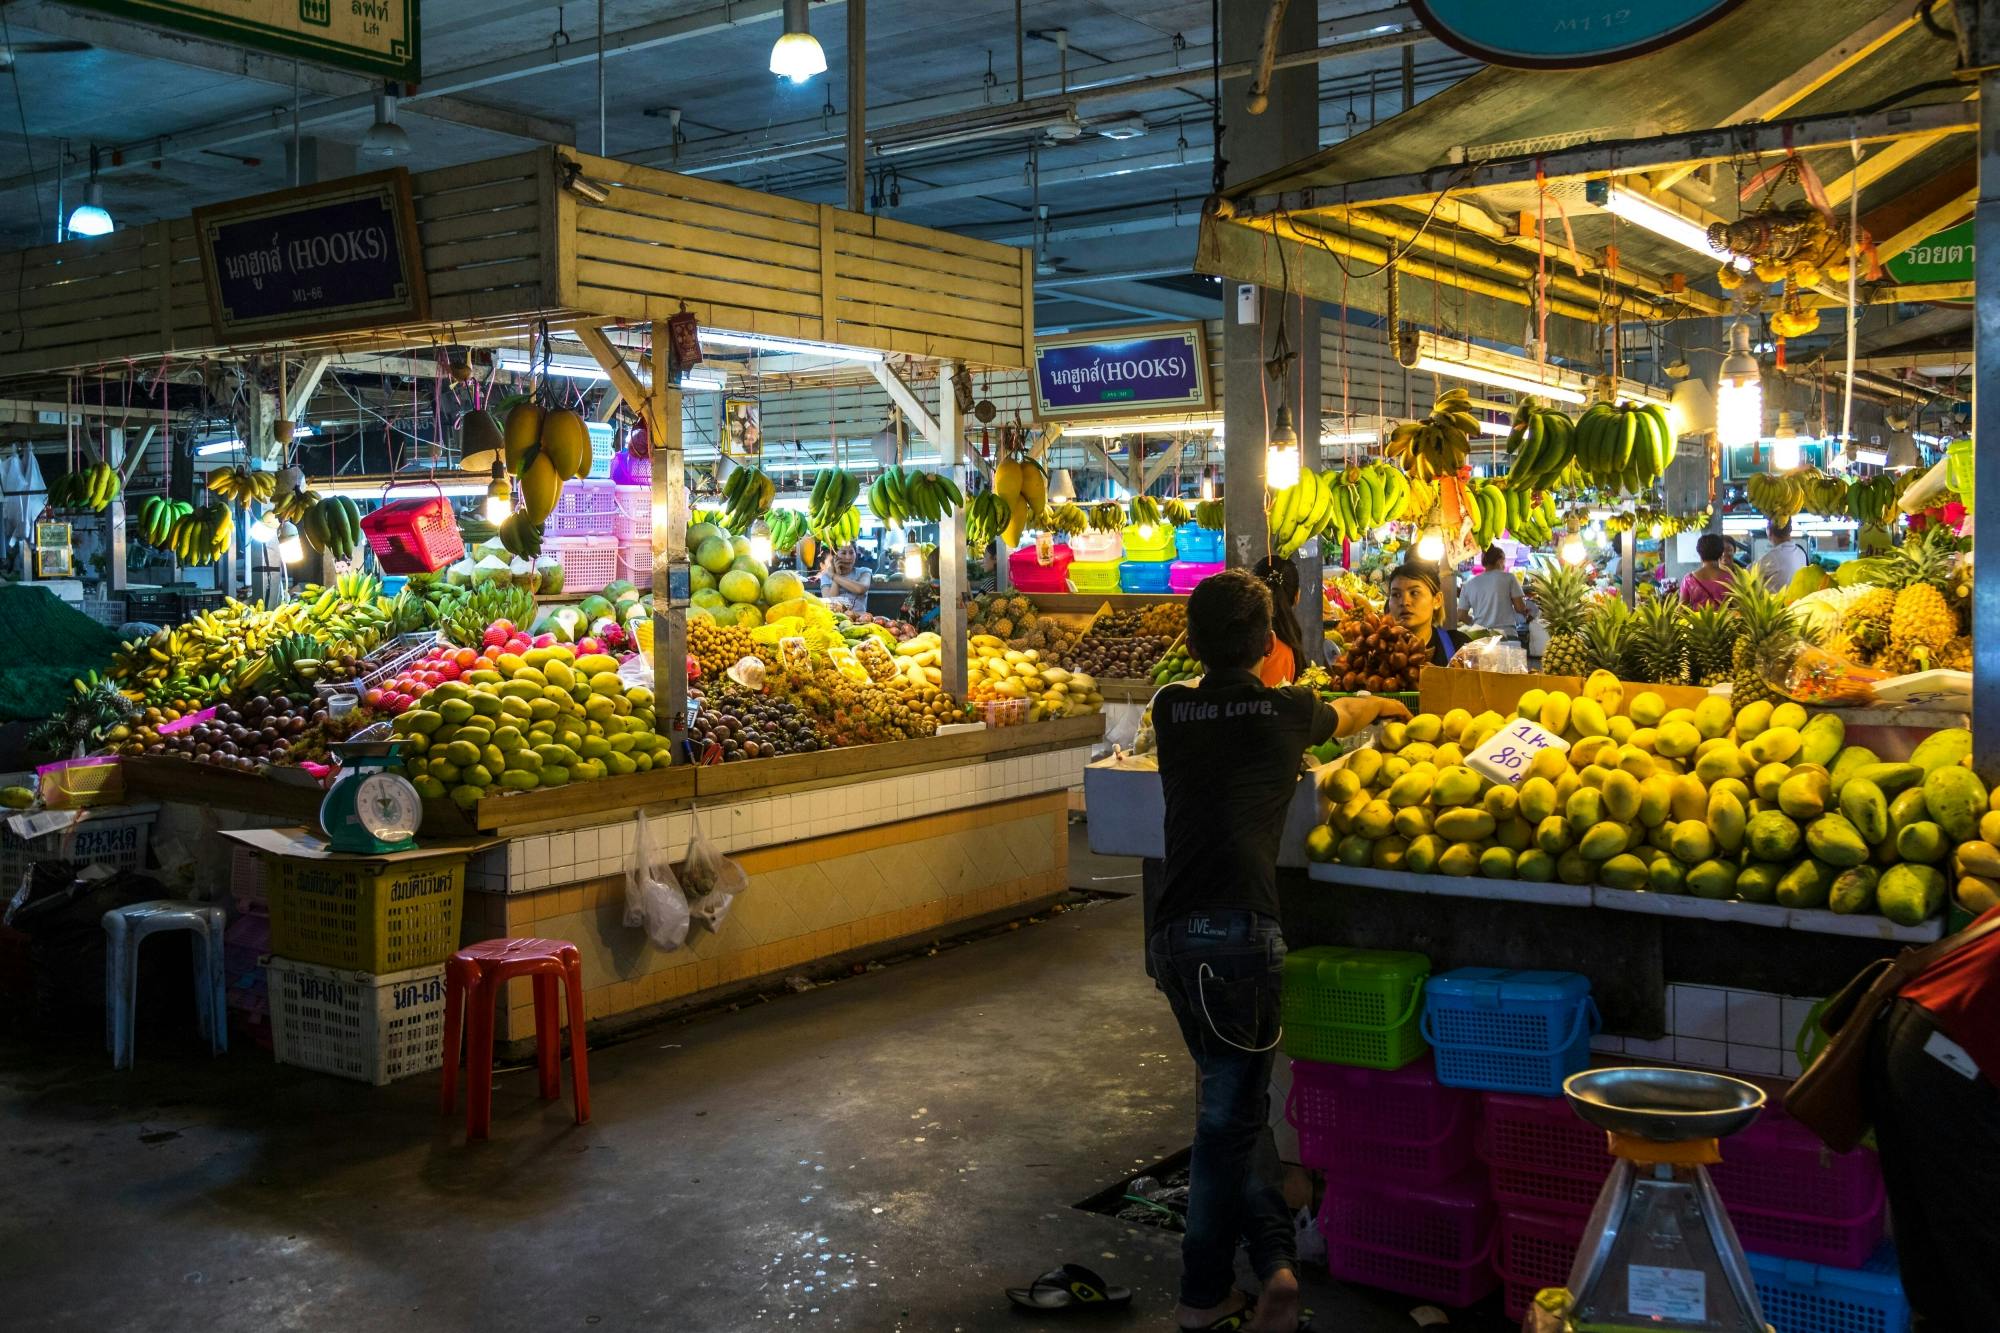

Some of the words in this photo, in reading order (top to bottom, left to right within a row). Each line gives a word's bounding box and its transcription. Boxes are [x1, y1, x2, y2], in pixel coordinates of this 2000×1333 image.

[363, 21, 380, 36] Lift
[288, 226, 388, 275] (HOOKS)
[1171, 700, 1219, 723] Wide
[1225, 699, 1280, 718] Love.
[1489, 747, 1522, 769] 80
[1187, 917, 1210, 935] LIVE
